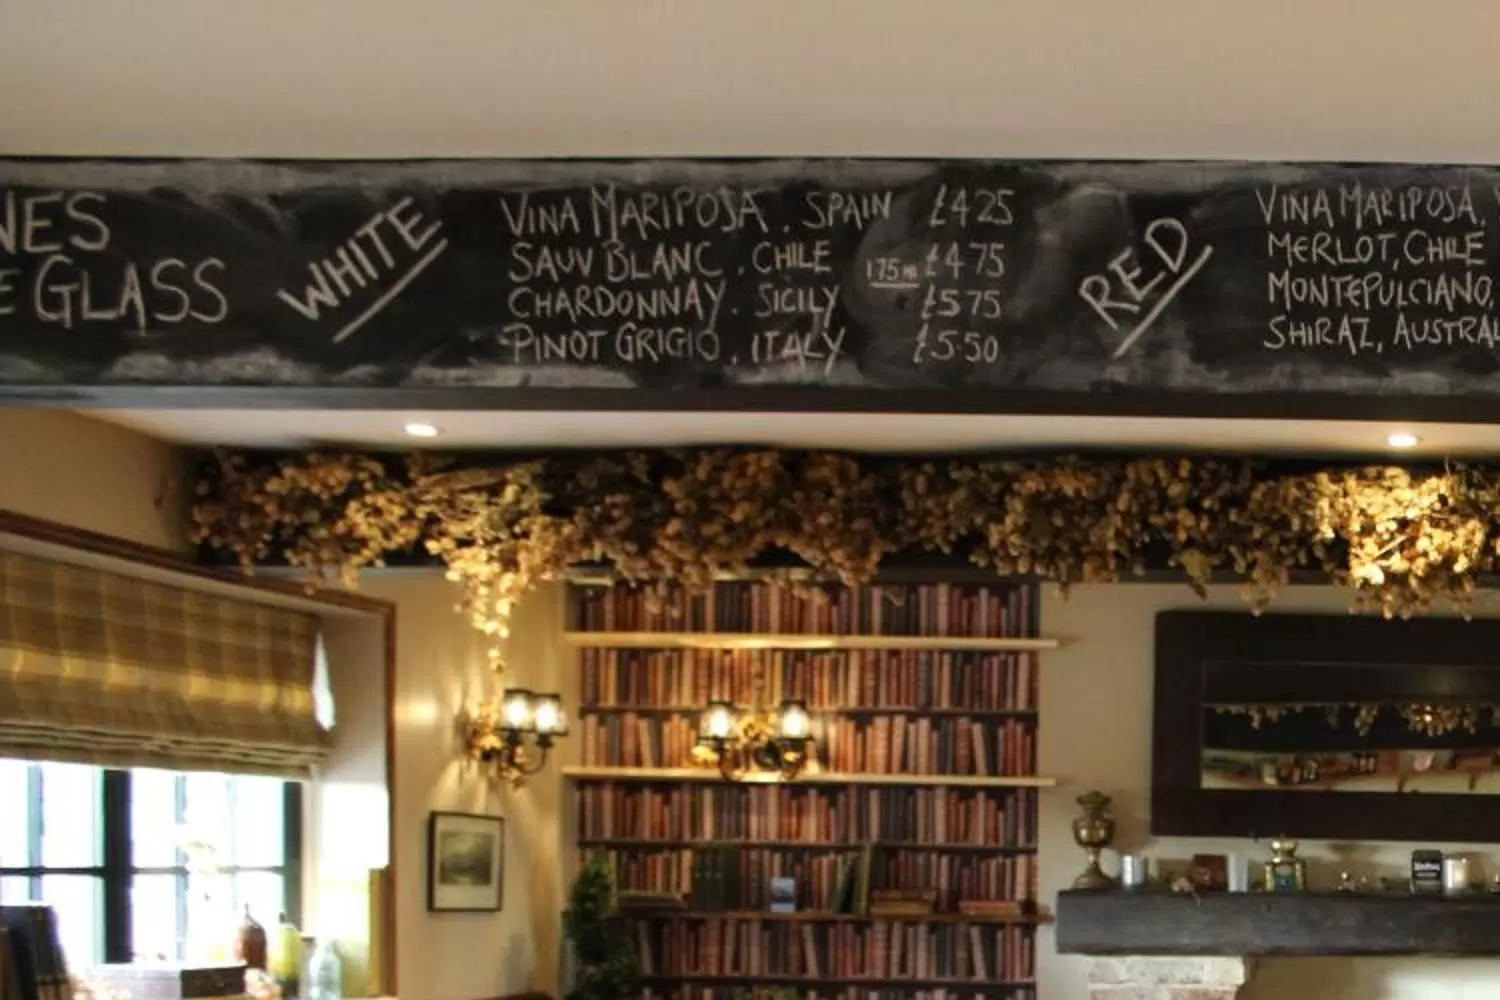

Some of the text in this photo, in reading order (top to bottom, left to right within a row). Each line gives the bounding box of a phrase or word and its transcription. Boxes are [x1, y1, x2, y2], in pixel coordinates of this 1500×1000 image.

[501, 190, 580, 237] VINA
[802, 190, 892, 231] SPAIN
[1255, 184, 1334, 228] VINA
[277, 197, 443, 321] WHITE
[508, 241, 594, 283] SAUV
[752, 240, 832, 274] CHILE
[1404, 229, 1486, 266] CHILE
[34, 253, 229, 336] GLASS
[1078, 217, 1188, 330] RED
[754, 283, 840, 328] SICILY
[498, 323, 608, 363] PINOT
[751, 327, 845, 376] ITALY
